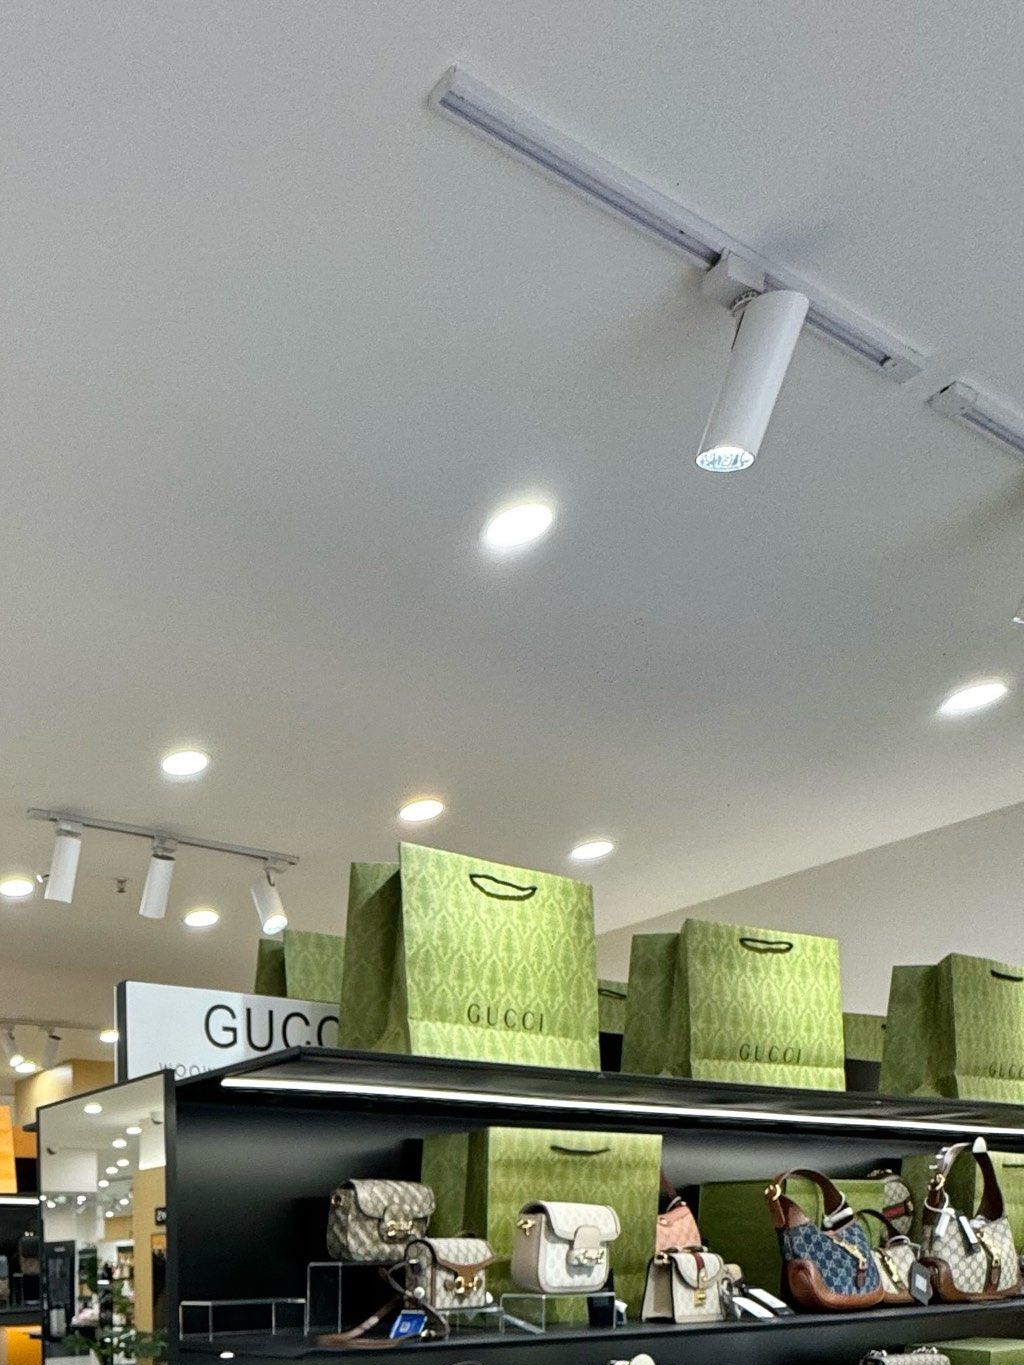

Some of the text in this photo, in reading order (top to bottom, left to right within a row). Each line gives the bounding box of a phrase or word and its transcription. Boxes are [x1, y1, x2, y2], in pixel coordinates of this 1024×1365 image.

[204, 1004, 340, 1052] GUCC
[467, 1003, 544, 1032] GUCCI
[739, 1043, 802, 1064] GUCCI
[988, 1061, 1024, 1079] GUCC
